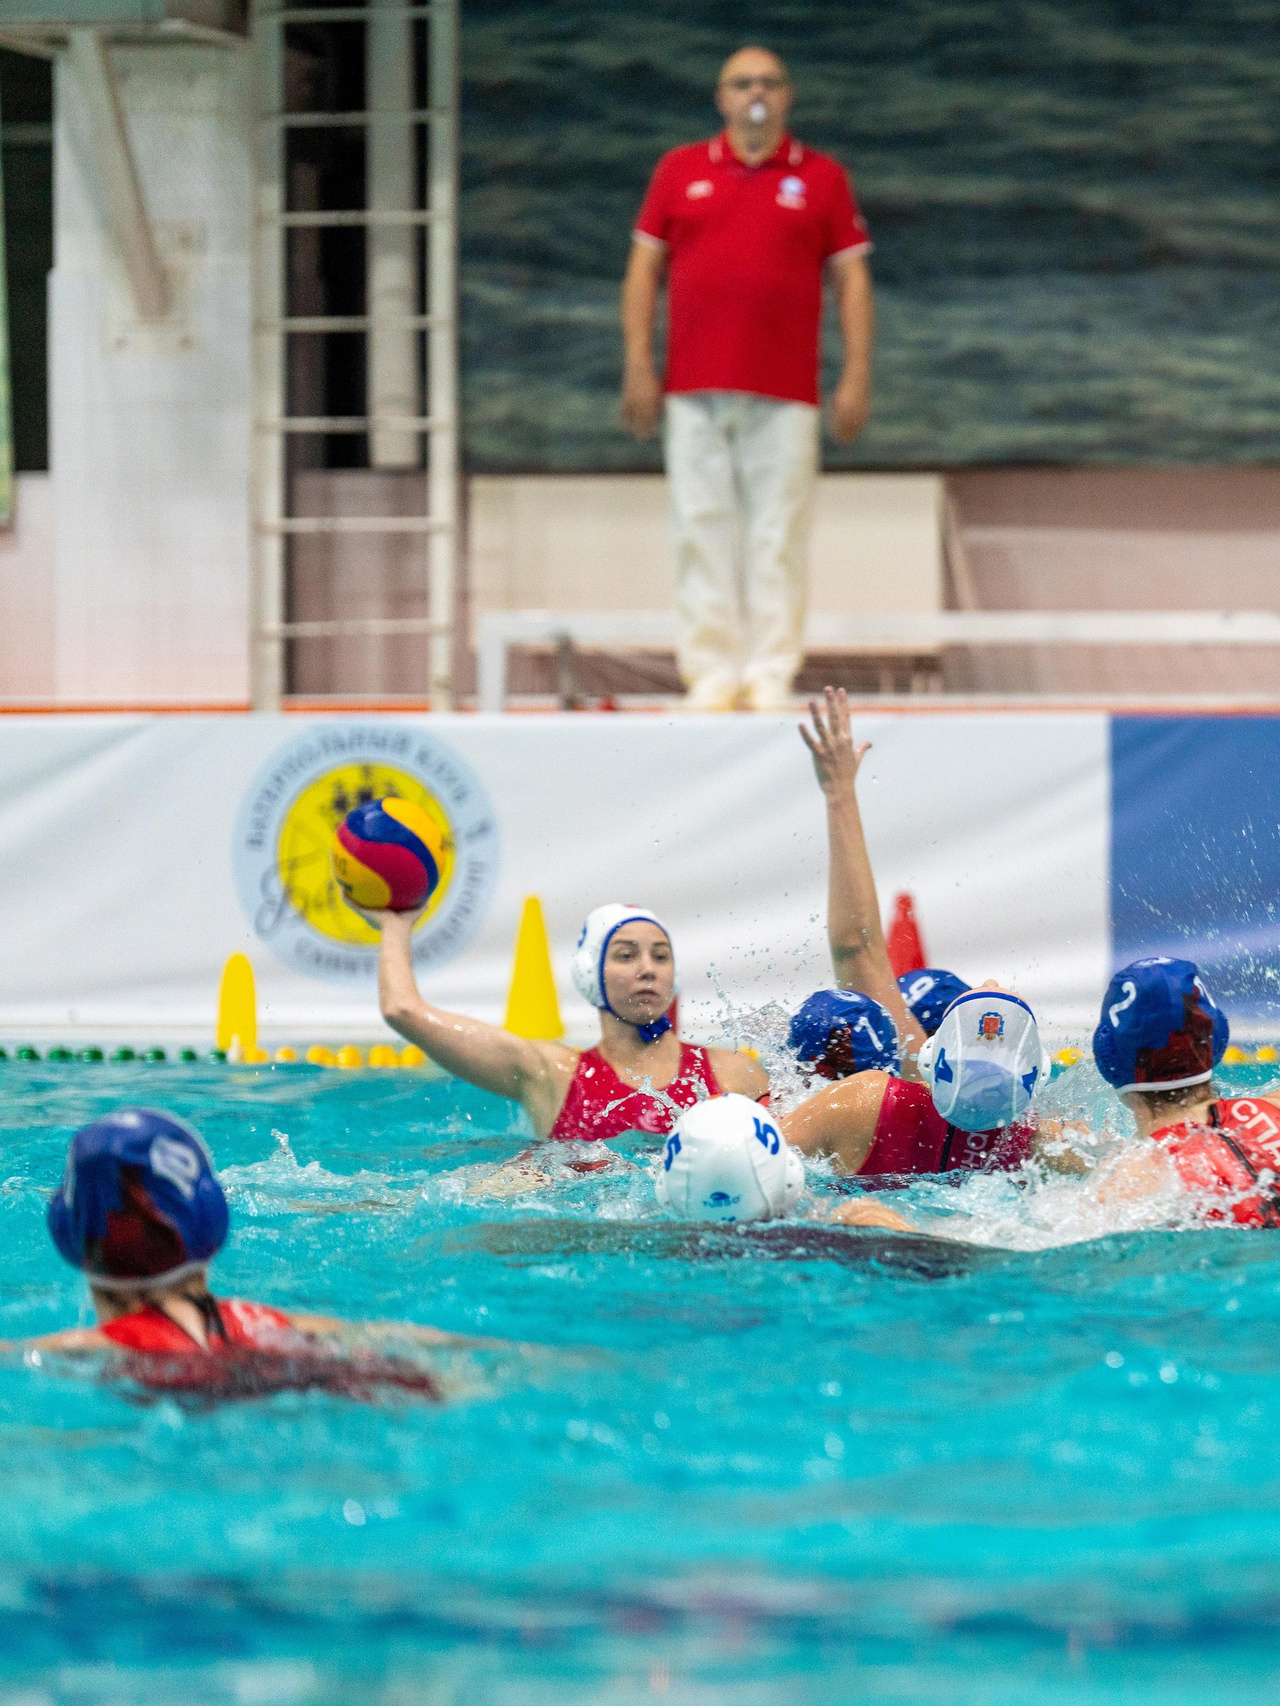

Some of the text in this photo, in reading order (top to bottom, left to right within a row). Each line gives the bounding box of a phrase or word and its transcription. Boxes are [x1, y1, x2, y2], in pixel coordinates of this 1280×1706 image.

[1108, 981, 1137, 1028] 2
[934, 1047, 954, 1084] 4
[664, 1132, 682, 1172] 5
[752, 1117, 780, 1156] 5
